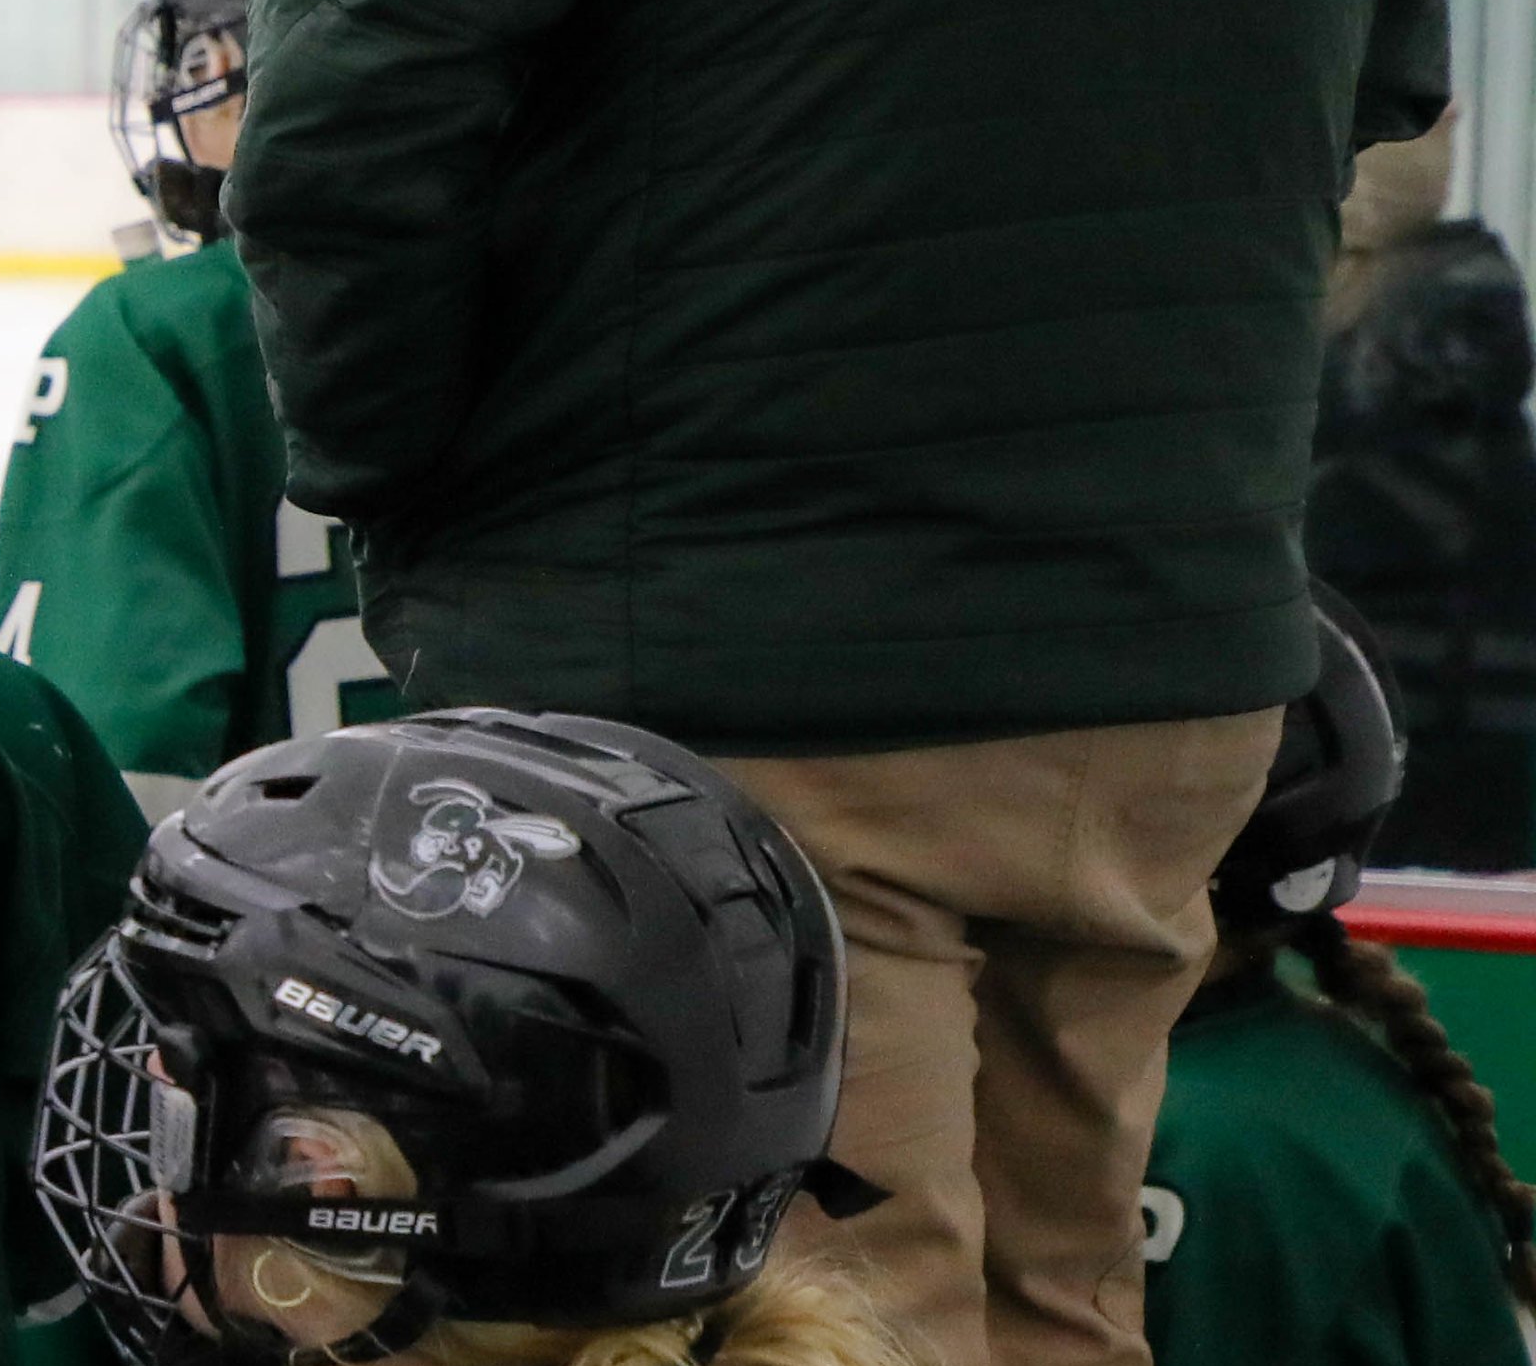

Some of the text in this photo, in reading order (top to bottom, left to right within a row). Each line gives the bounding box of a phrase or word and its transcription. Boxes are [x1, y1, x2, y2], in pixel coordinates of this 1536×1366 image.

[14, 357, 68, 444] P
[274, 978, 442, 1065] BAUER
[308, 1208, 438, 1236] BAUER
